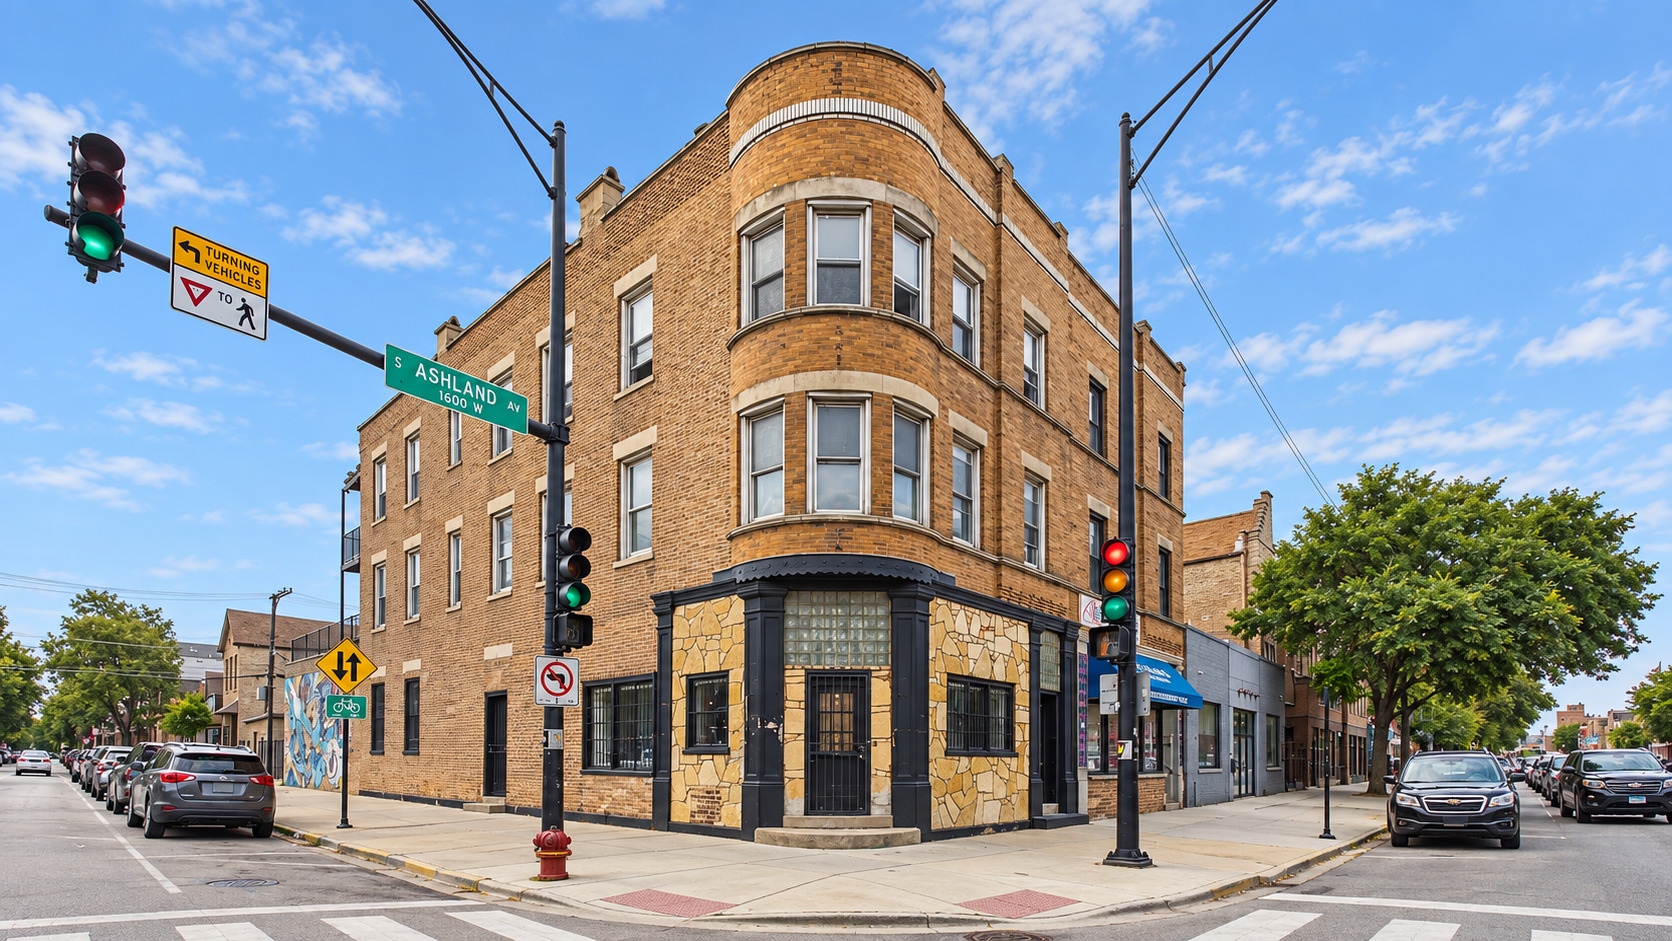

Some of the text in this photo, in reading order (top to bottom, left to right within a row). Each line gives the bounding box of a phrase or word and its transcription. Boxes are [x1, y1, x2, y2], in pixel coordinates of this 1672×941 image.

[205, 245, 260, 276] TURNING
[205, 259, 262, 290] VEHICLES
[218, 290, 233, 305] TO
[394, 356, 521, 413] S ASHLAND AV
[439, 390, 483, 414] 1600 W
